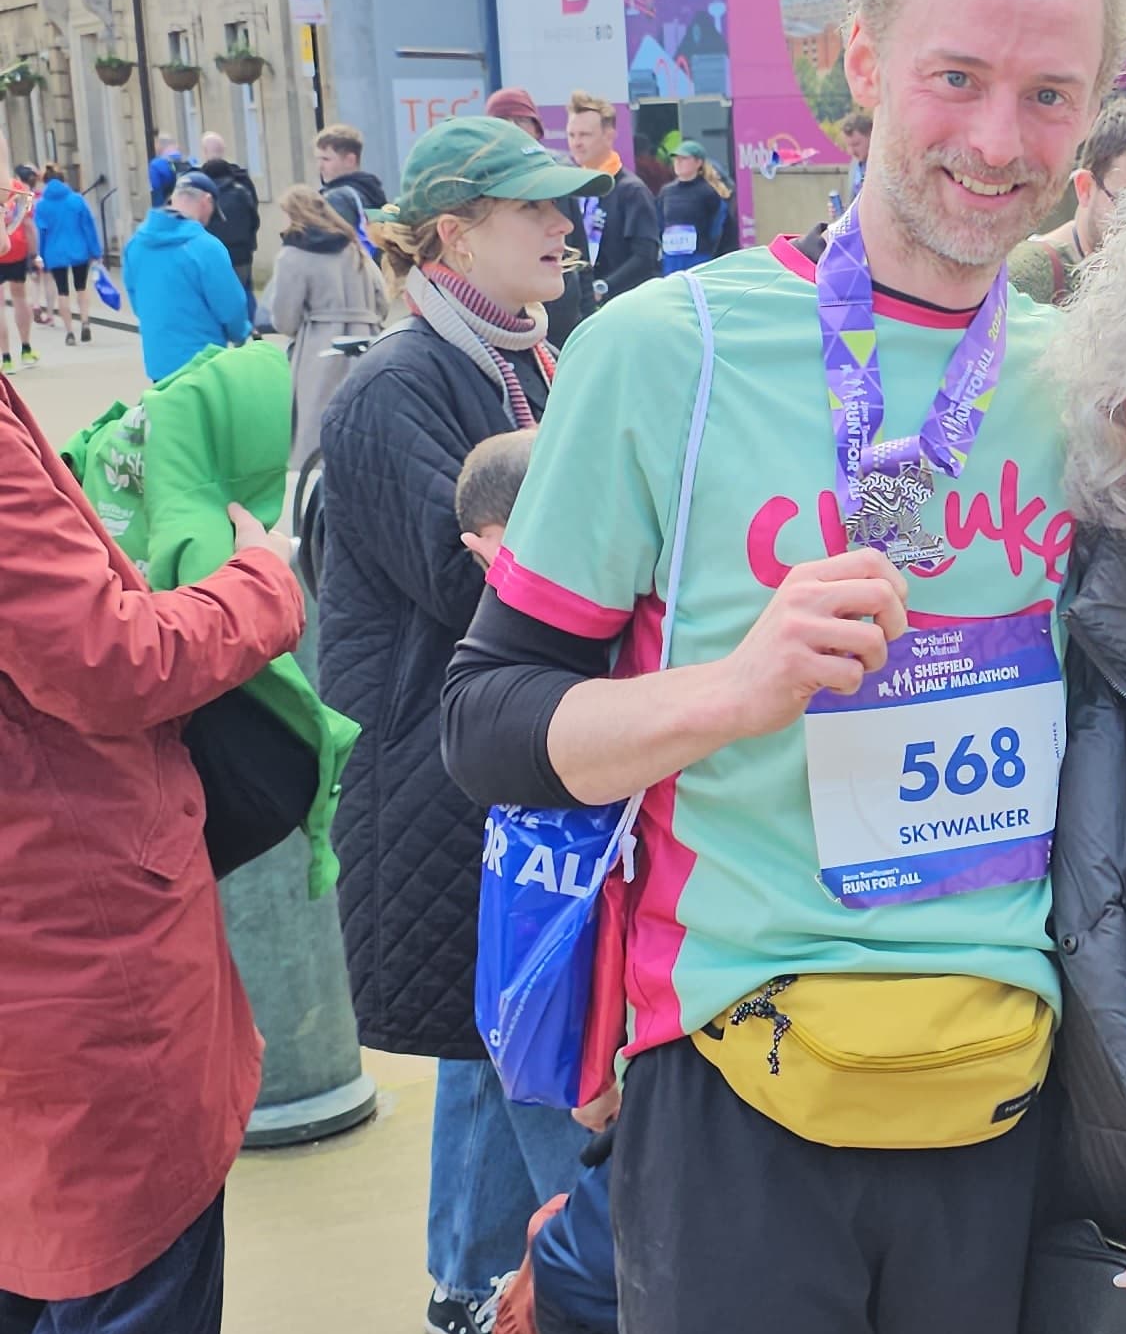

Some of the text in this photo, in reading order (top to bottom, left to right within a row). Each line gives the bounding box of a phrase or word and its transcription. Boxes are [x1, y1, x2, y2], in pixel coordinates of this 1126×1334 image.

[965, 368, 986, 397] FOR
[977, 347, 995, 372] ALL
[845, 400, 860, 435] RUN
[846, 437, 860, 472] FOR
[927, 630, 963, 646] Sheffield
[930, 644, 960, 656] Mutual
[914, 657, 974, 678] SHEFFIELD
[914, 665, 1020, 694] HALF MARATHON
[899, 726, 1026, 803] 568
[899, 808, 1031, 845] SKYWALKER
[842, 871, 922, 895] RUN FOR ALL
